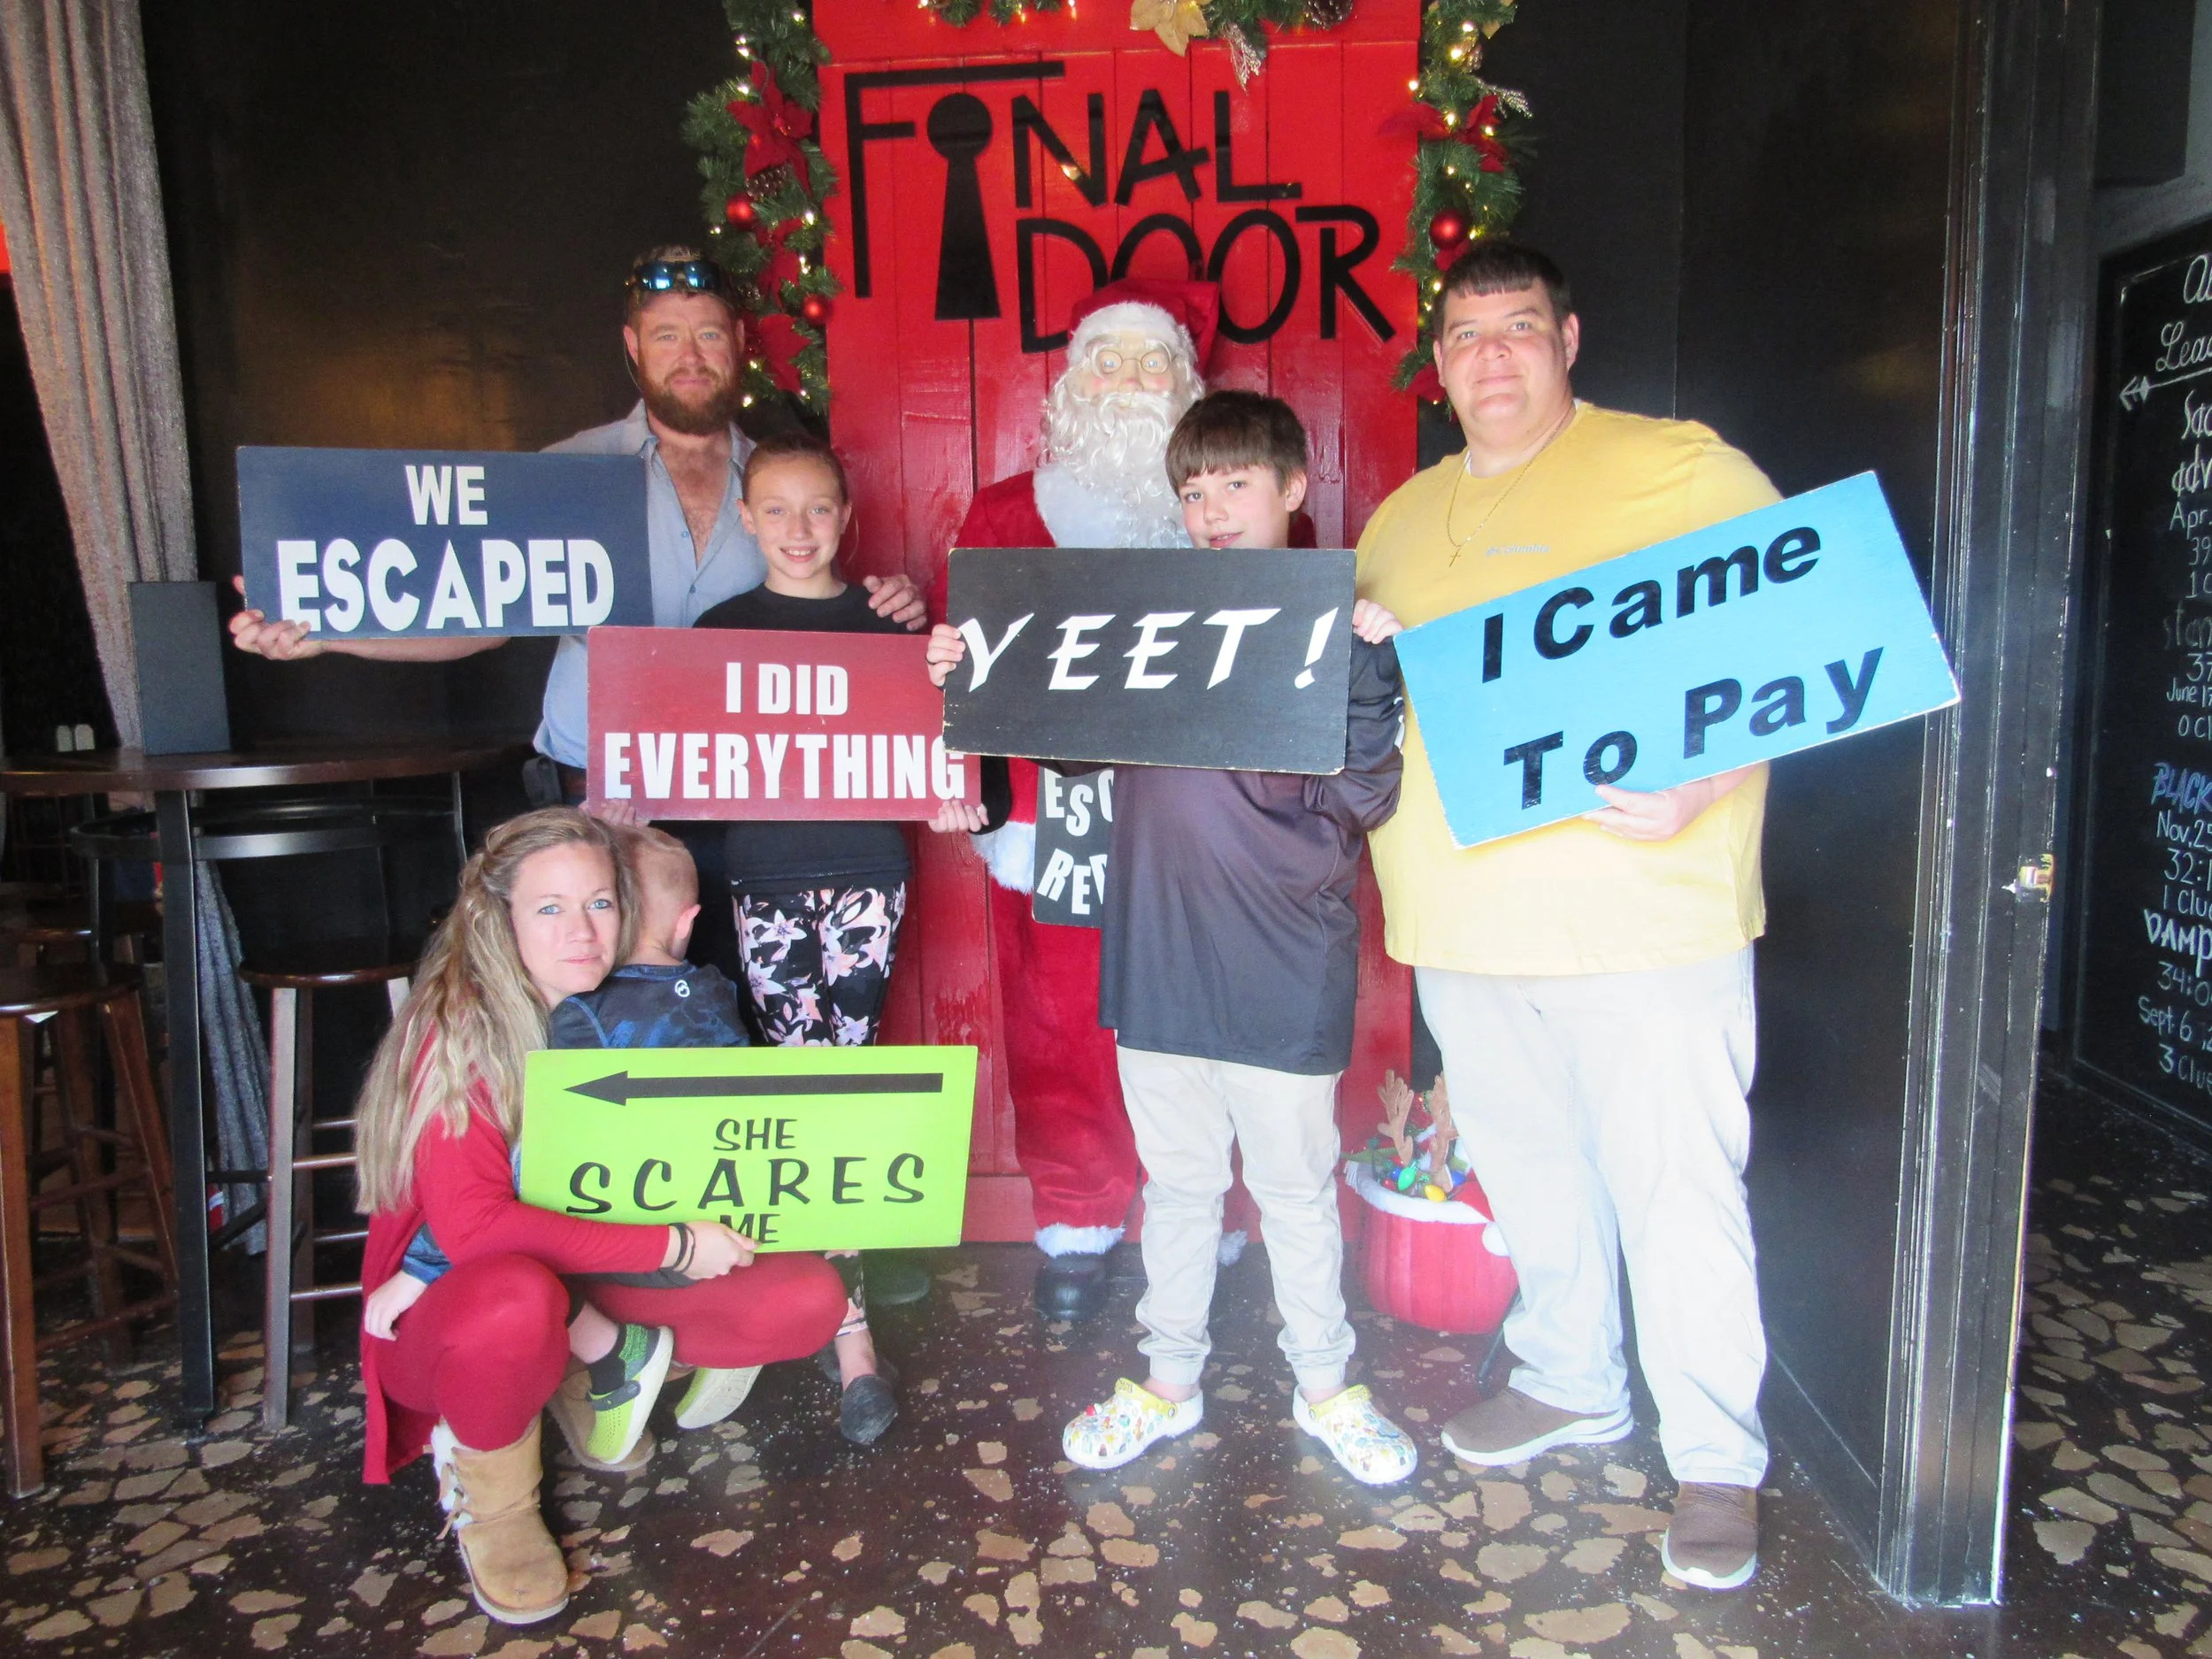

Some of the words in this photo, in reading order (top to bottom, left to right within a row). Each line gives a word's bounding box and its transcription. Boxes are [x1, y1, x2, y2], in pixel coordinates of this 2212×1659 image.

[405, 465, 488, 525] WE
[277, 538, 614, 632] ESCAPED
[1482, 613, 1503, 683] I
[1533, 526, 1821, 660] Came
[726, 662, 741, 713] I
[758, 663, 848, 716] DID
[2166, 677, 2197, 702] June
[1504, 731, 1637, 810] To
[1684, 646, 1884, 760] Pay
[605, 733, 964, 800] EVERYTHING
[714, 1118, 797, 1152] SHE
[566, 1153, 926, 1214] SCARES
[719, 1212, 781, 1245] ME
